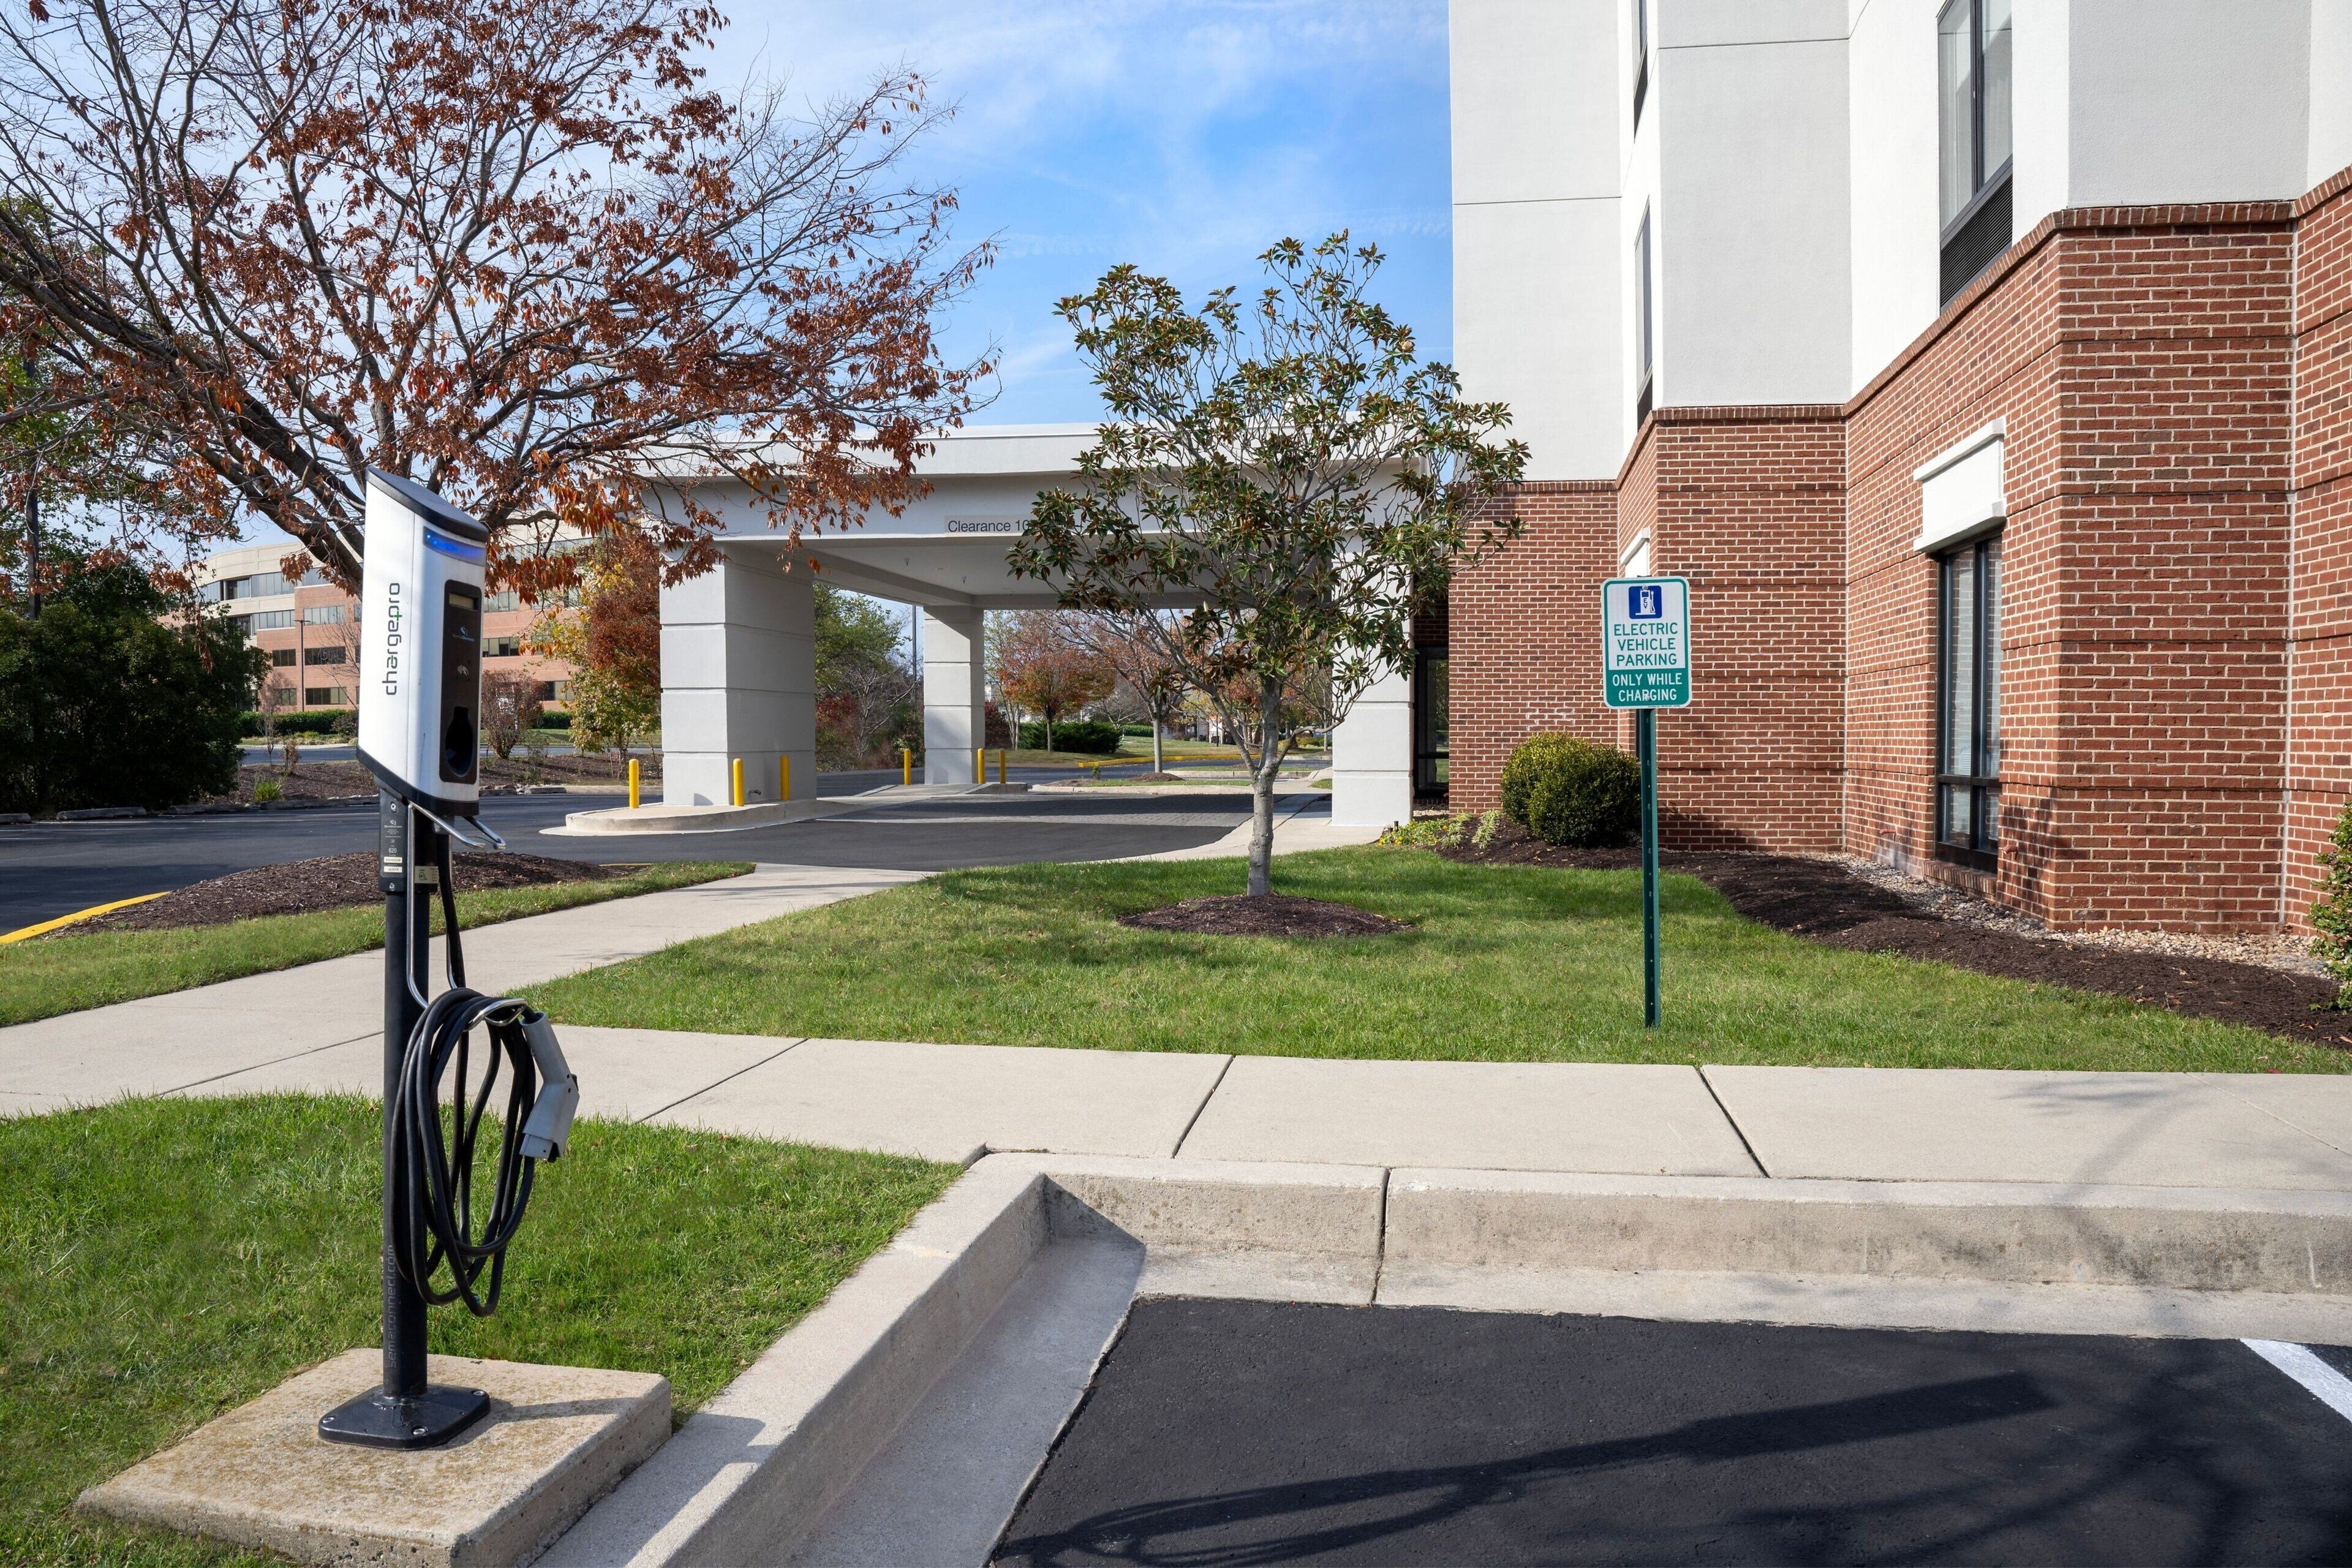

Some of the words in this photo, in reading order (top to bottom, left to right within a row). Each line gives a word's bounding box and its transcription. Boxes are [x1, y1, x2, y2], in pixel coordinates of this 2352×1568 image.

[948, 520, 1011, 532] Clearance
[1643, 598, 1648, 609] EV
[1614, 622, 1678, 636] ELECTRIC
[382, 582, 402, 695] chargepro
[1618, 638, 1676, 651] VEHICLE
[1616, 654, 1677, 666] PARKING
[1612, 674, 1643, 686] ONLY
[1647, 673, 1683, 685] WHILE
[1618, 688, 1677, 702] CHARGING
